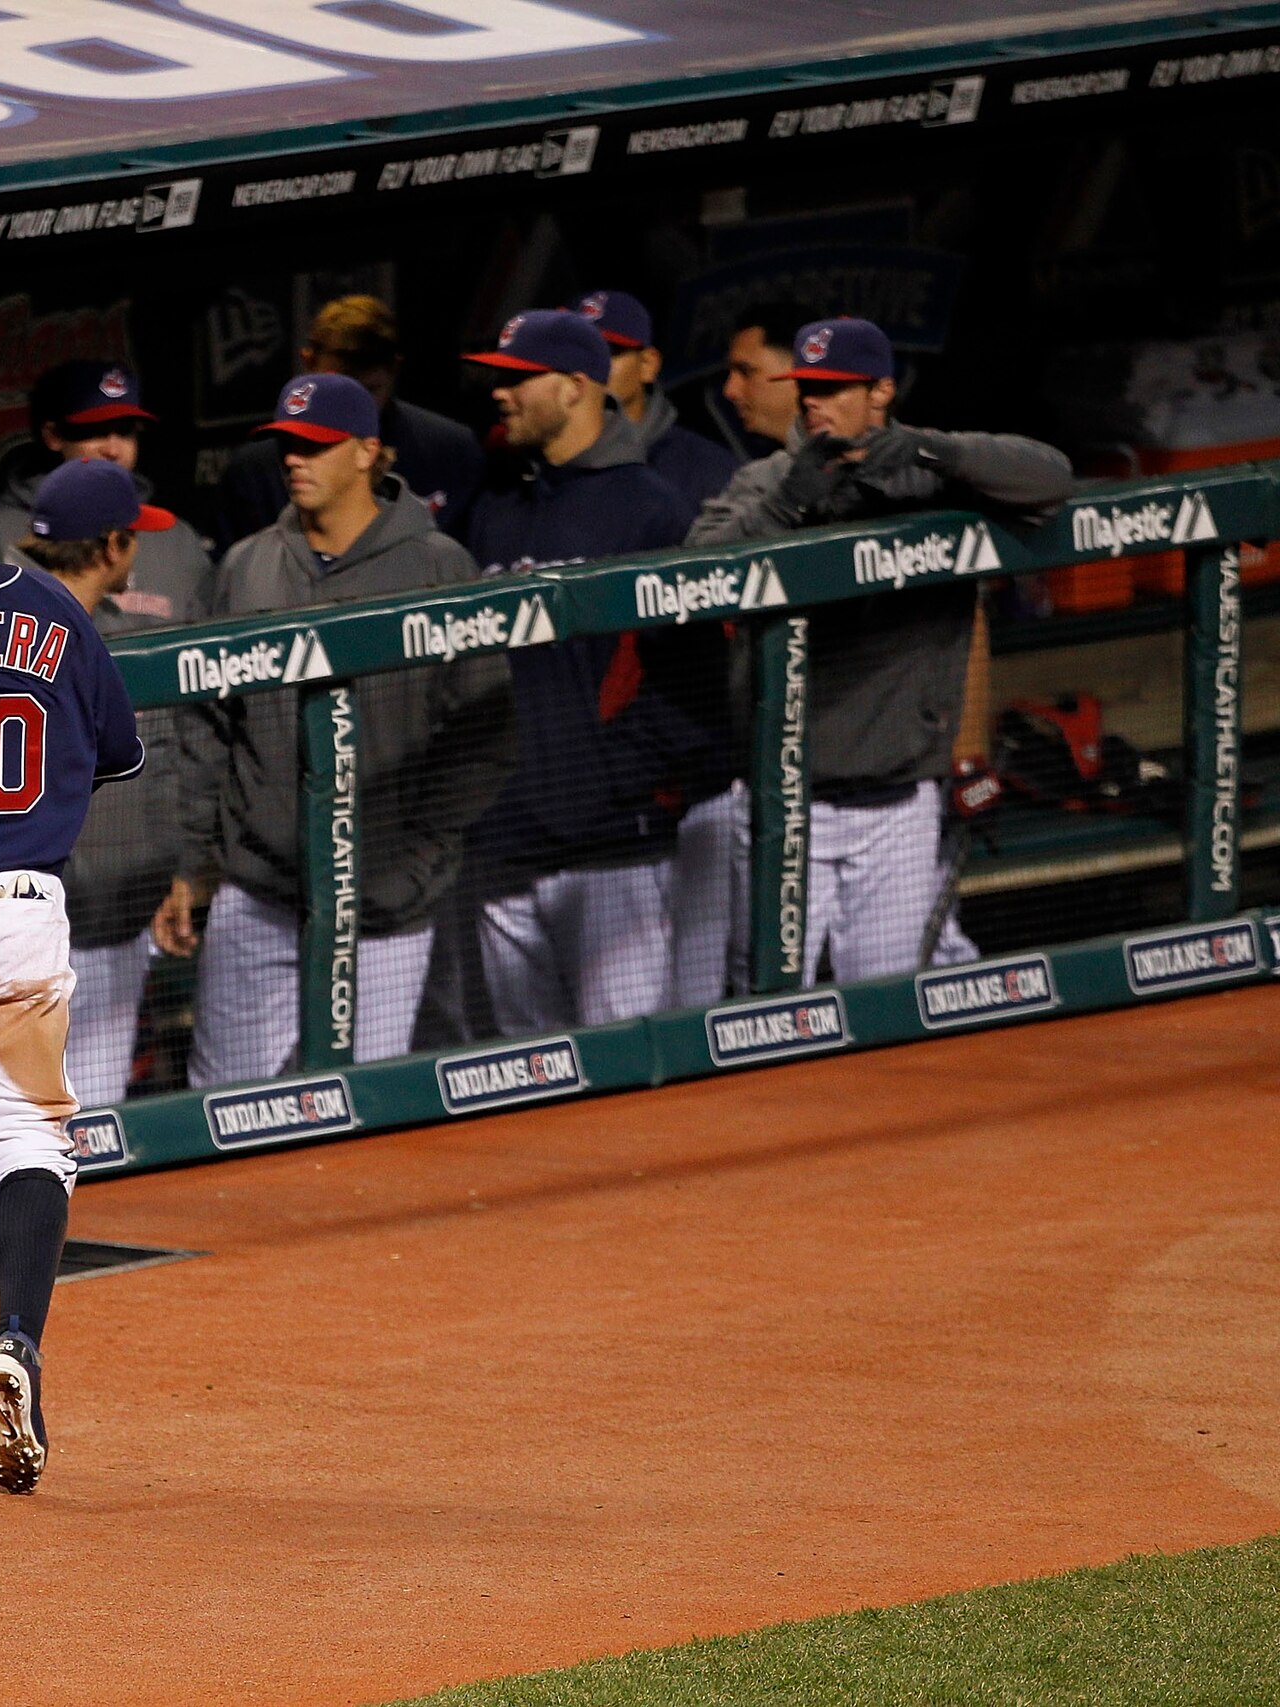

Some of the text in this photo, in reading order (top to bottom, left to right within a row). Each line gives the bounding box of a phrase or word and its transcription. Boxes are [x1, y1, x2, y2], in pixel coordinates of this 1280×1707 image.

[1071, 503, 1172, 558] Majestic
[853, 537, 954, 590] Majestic
[634, 569, 740, 624] Majestic
[402, 607, 509, 662] Majestic
[177, 640, 281, 698] Majestic
[779, 617, 809, 974] MAJESTICATHLETIC.COM
[329, 687, 356, 1050] MAJESTICATHLETIC.COM
[1133, 931, 1254, 981] INDIANS.COM
[924, 966, 1046, 1018] INDIANS.COM
[714, 1003, 840, 1057] INDIANS.COM
[445, 1046, 576, 1100] INDIANS.COM
[215, 1083, 346, 1136] INDIANS.COM
